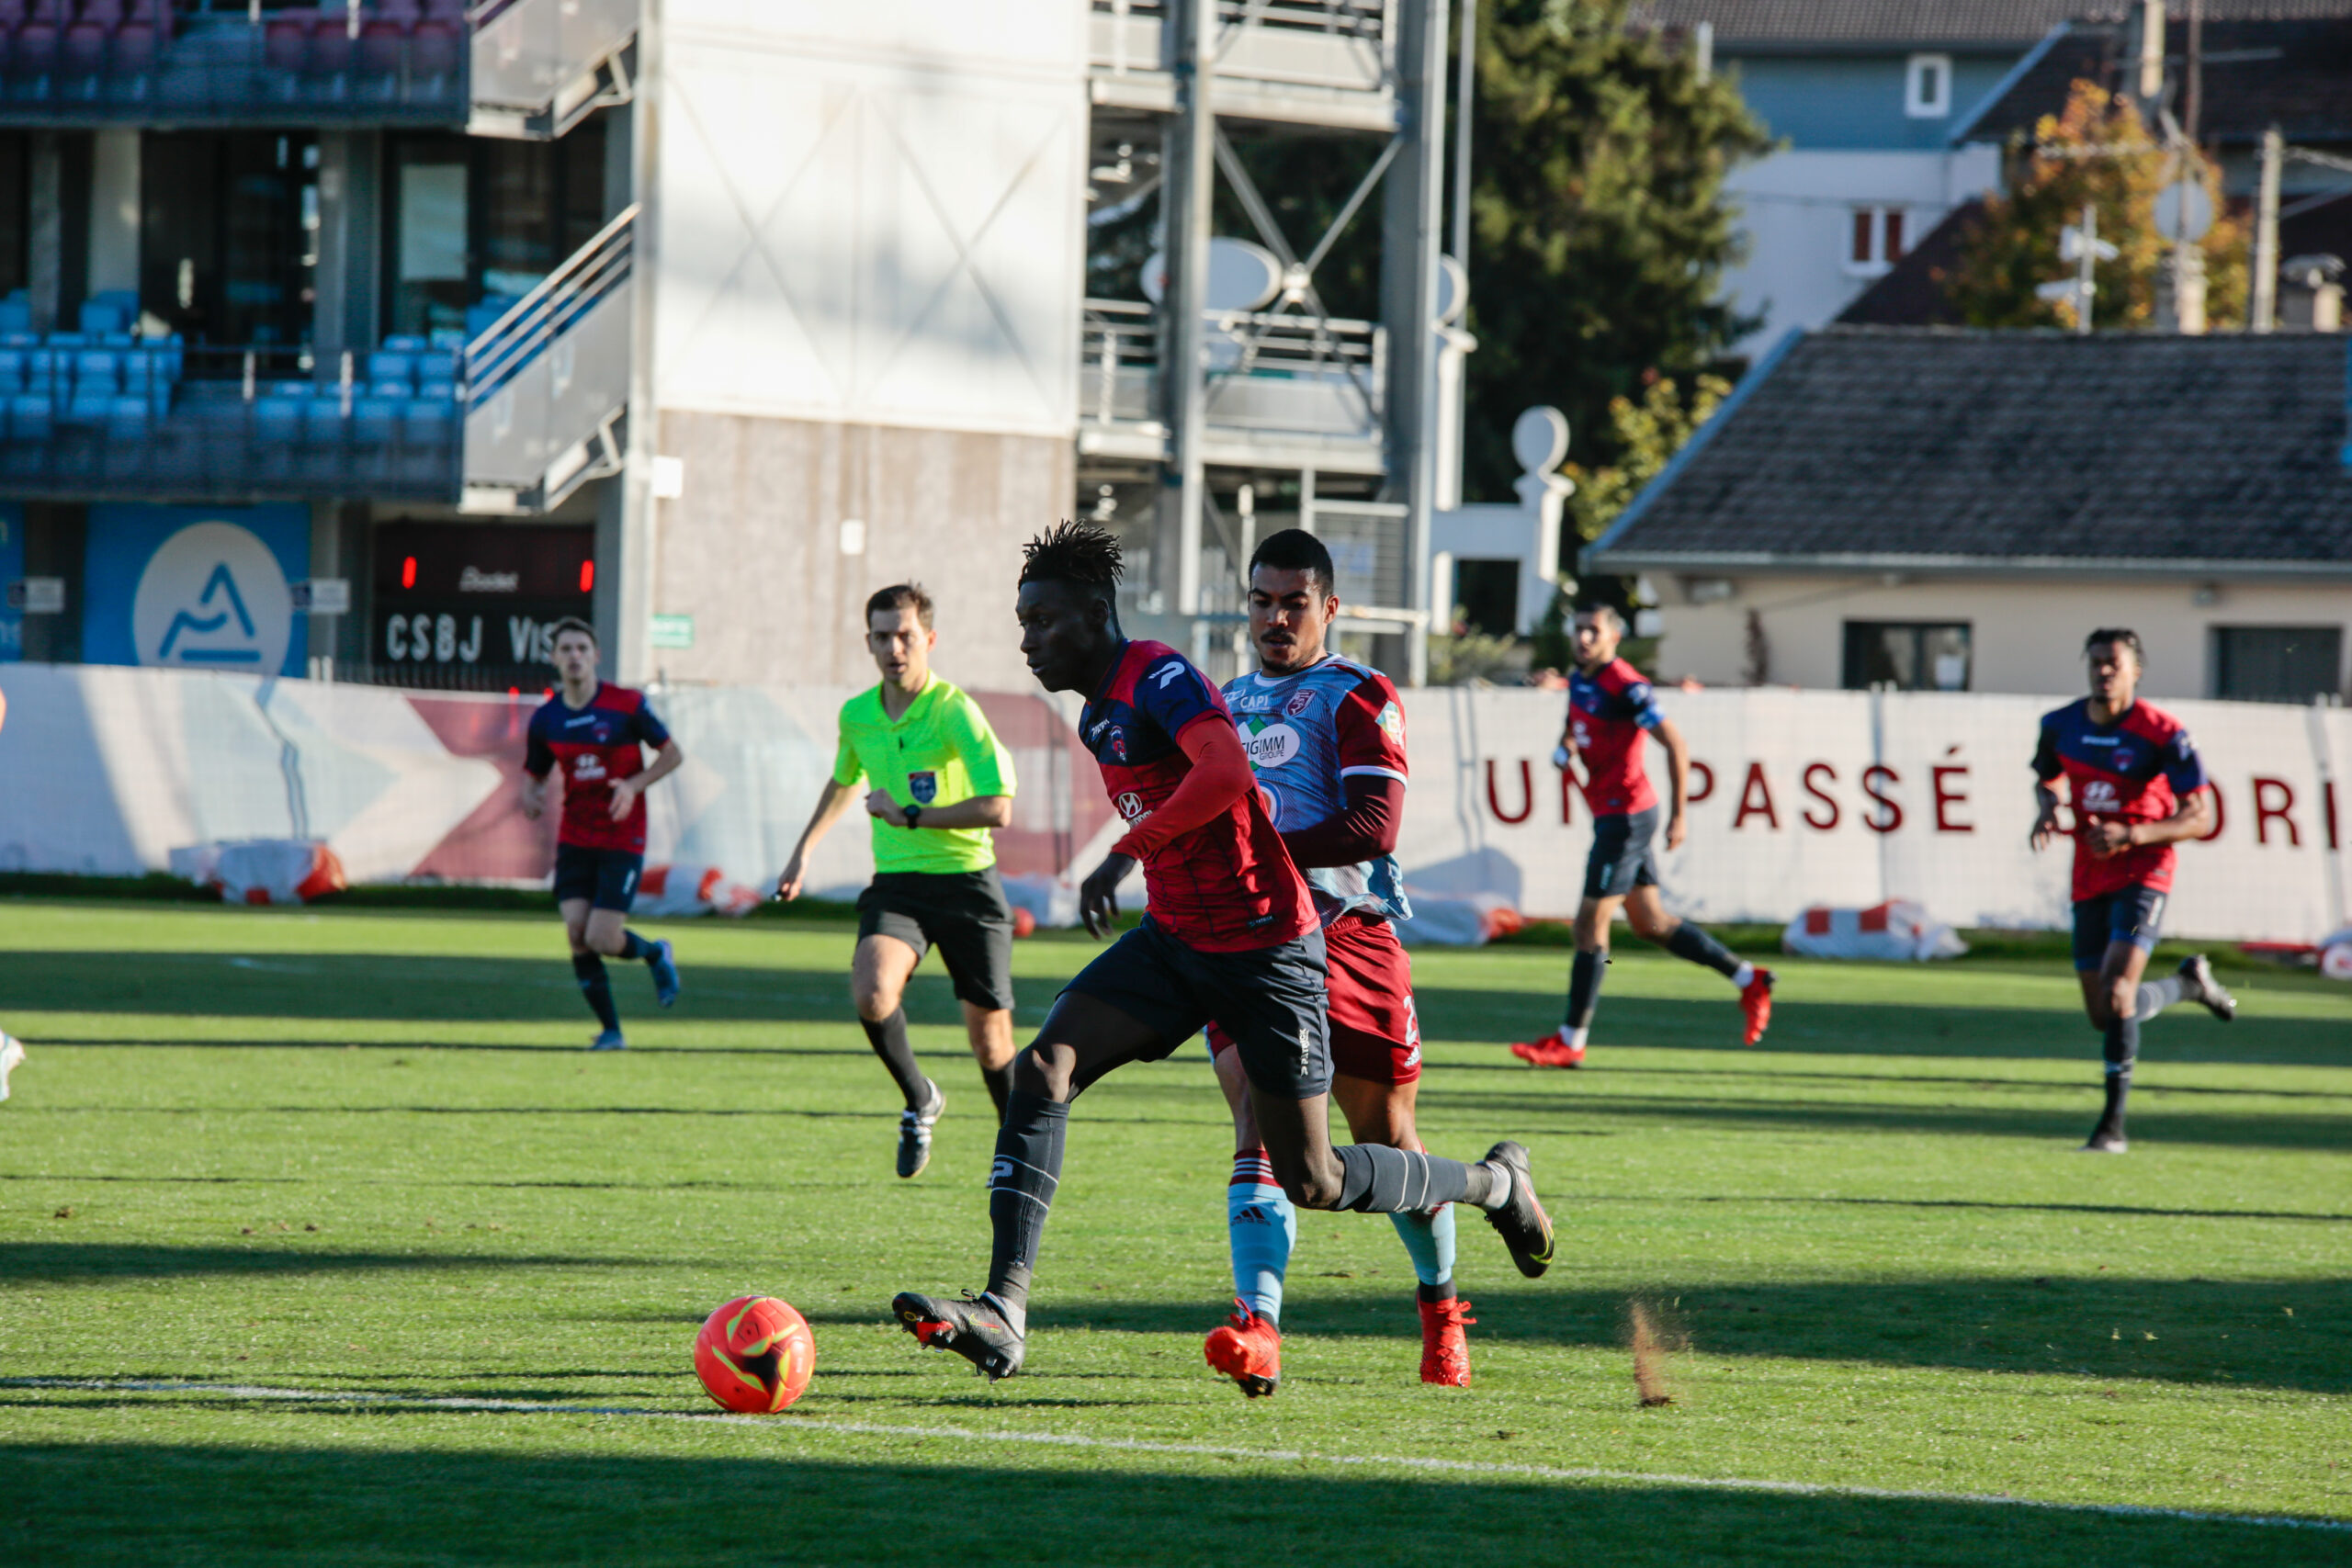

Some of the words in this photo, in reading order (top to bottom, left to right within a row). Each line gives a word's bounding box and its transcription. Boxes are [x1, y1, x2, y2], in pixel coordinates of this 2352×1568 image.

[386, 614, 482, 663] CSBJ
[1240, 695, 1269, 708] CAPI
[1298, 1028, 1310, 1065] PATRICK
